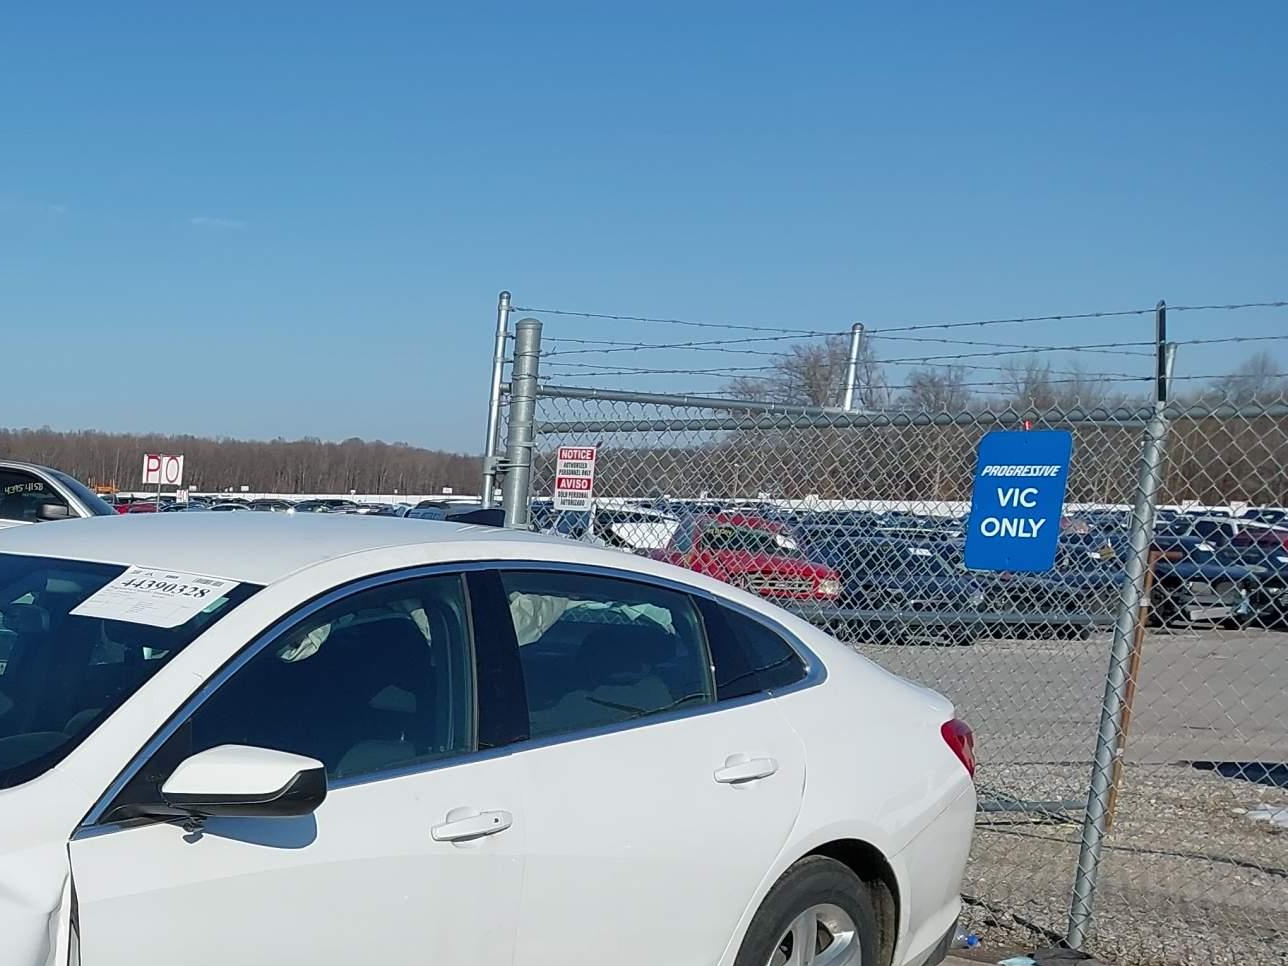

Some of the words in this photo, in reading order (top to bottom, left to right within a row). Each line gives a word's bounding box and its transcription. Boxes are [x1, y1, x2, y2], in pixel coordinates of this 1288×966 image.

[561, 449, 592, 459] NOTICE
[981, 465, 1062, 477] PROGRESSIVE
[560, 479, 588, 489] AVISO
[997, 487, 1039, 508] VIC
[980, 517, 1046, 538] ONLY
[121, 578, 211, 599] 44390328
